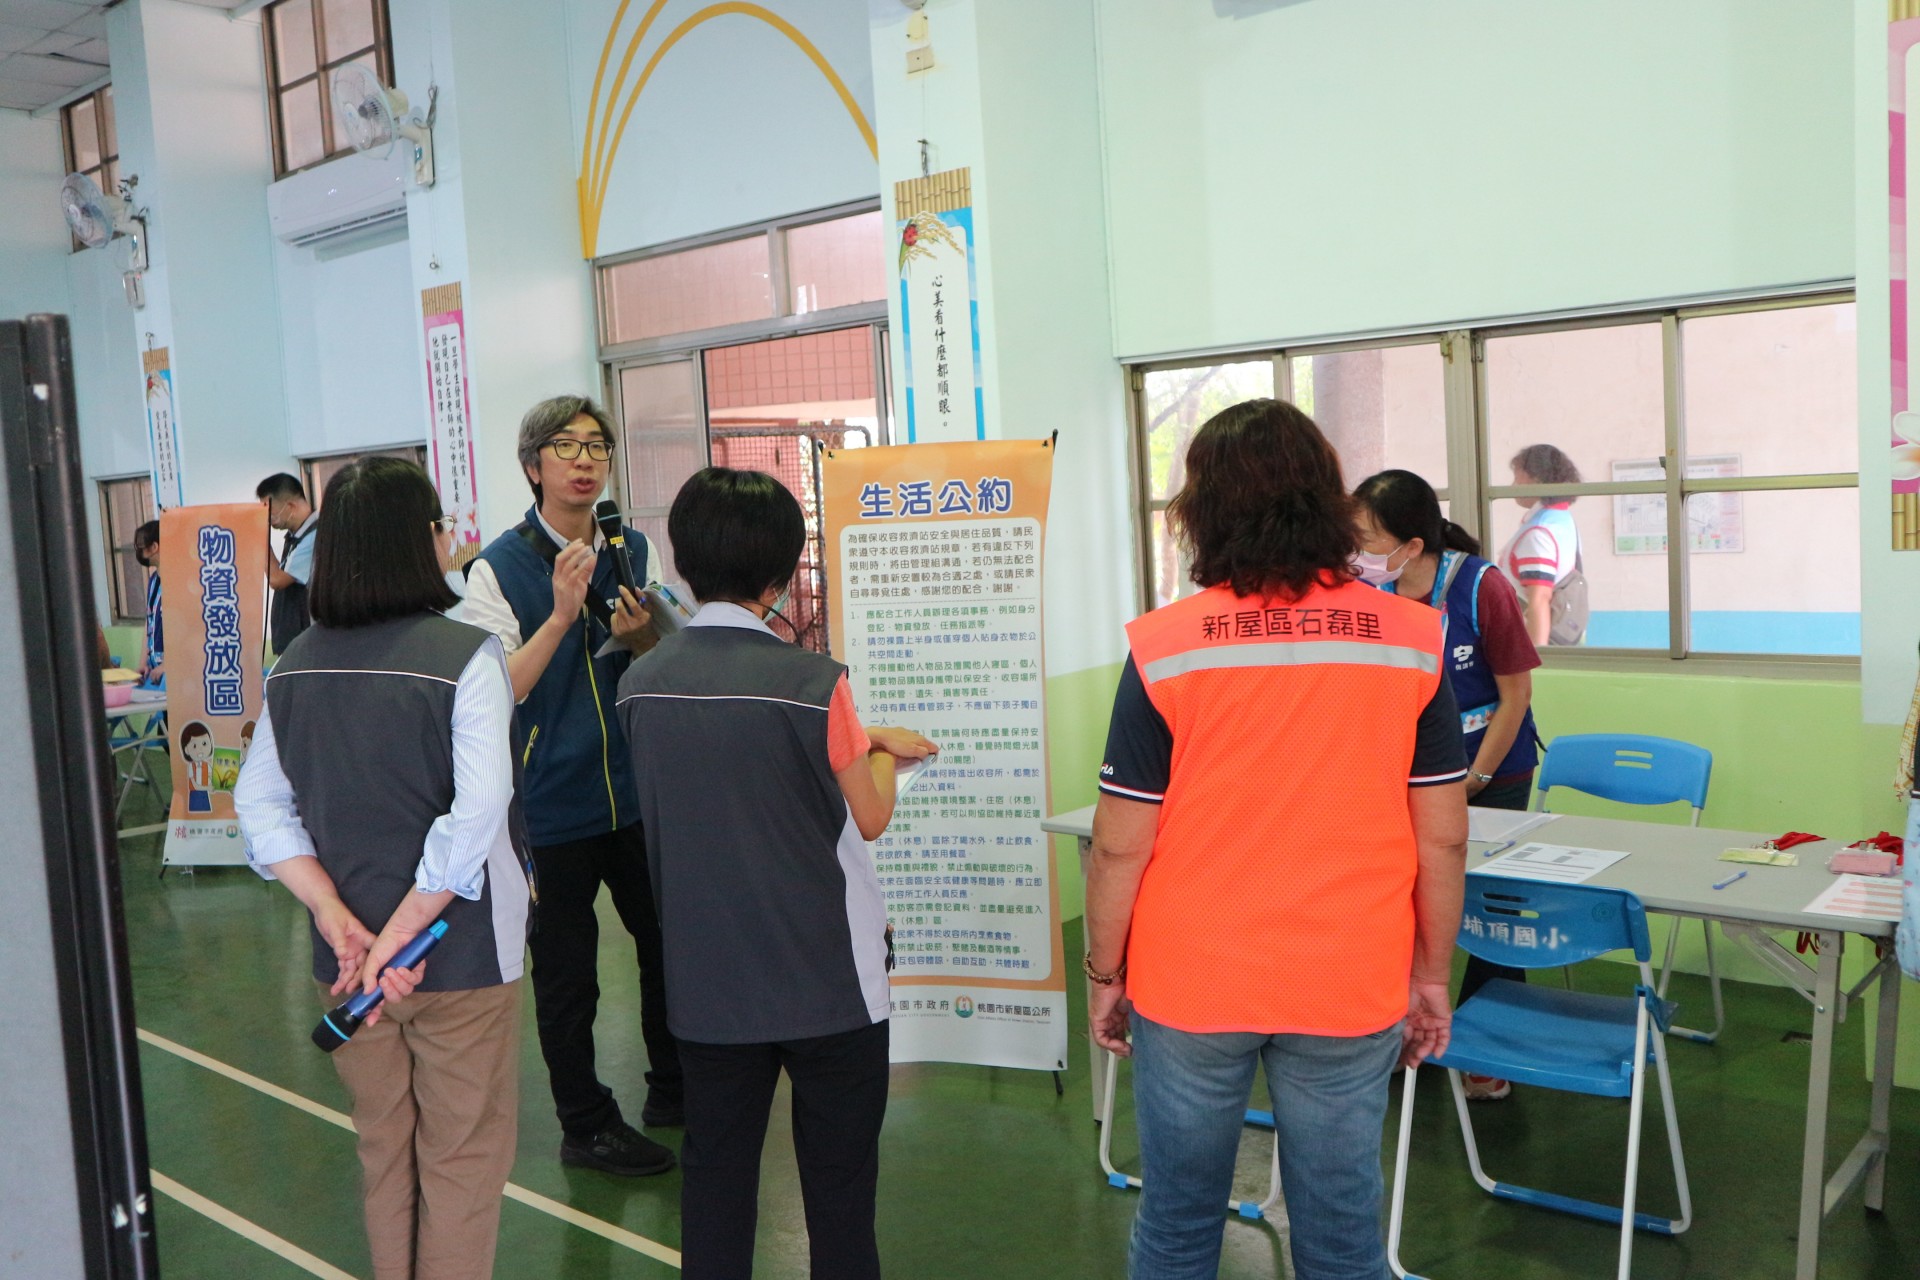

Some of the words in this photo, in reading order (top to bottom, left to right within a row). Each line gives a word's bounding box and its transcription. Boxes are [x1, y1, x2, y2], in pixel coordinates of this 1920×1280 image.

[860, 477, 1012, 518] 生活公約
[199, 526, 243, 715] 物資發放區
[1202, 607, 1382, 641] 新屋區石磊里
[1463, 914, 1569, 949] 埔頂國小
[978, 1003, 1050, 1016] 桃園市新屋區公所
